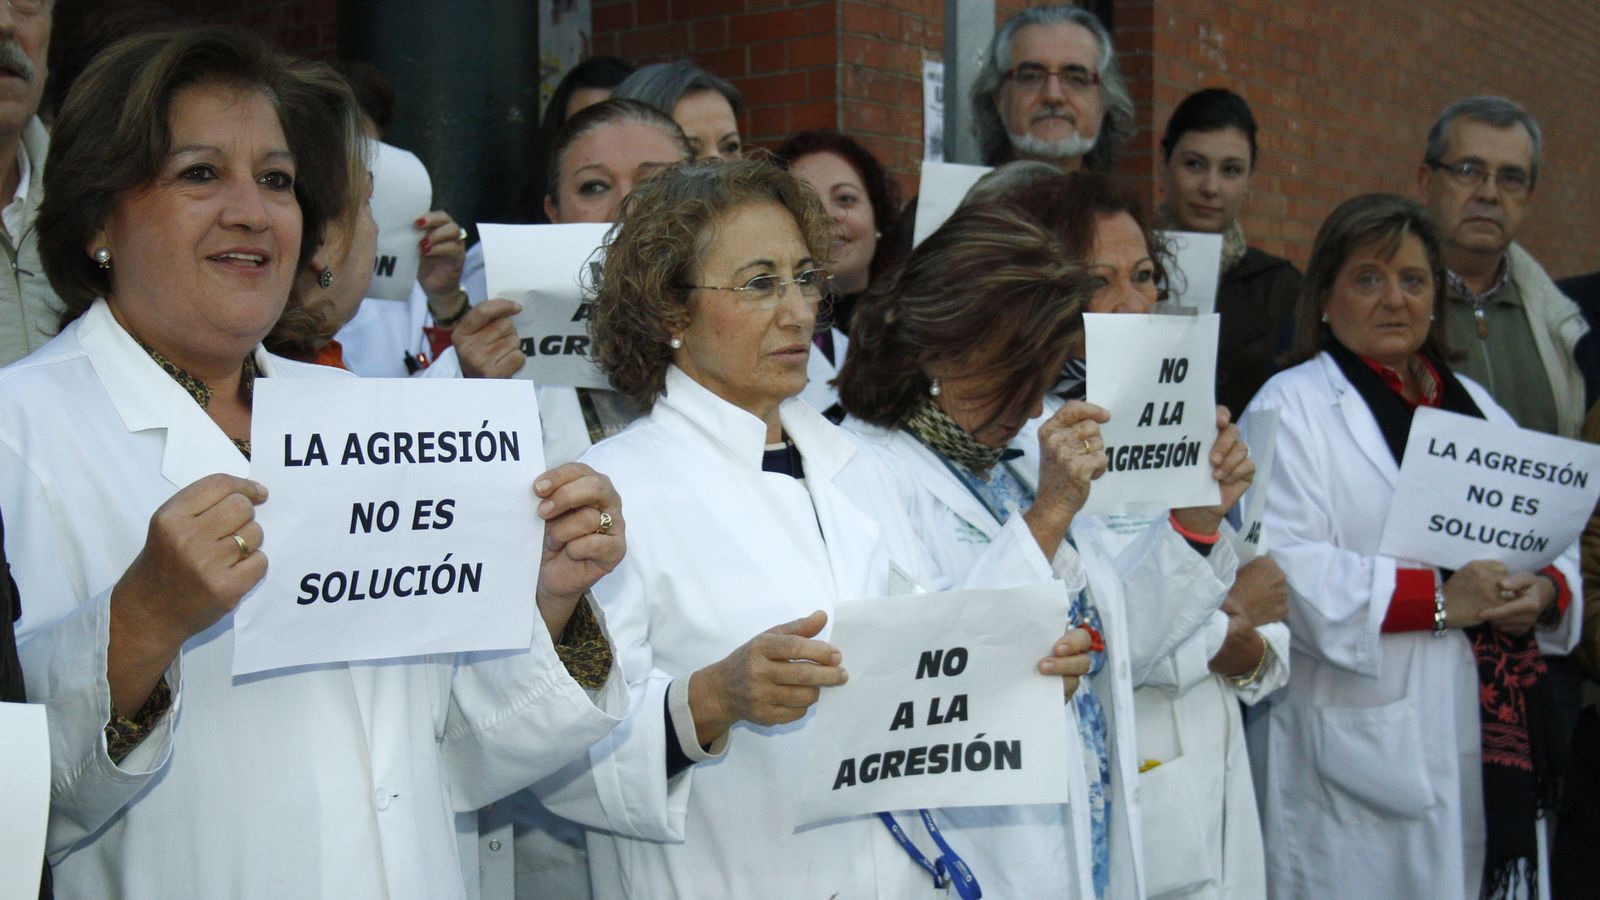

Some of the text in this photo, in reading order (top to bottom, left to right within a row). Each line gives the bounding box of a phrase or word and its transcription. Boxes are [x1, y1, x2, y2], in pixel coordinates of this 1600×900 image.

[1158, 357, 1188, 383] NO
[1137, 401, 1185, 428] A LA
[284, 420, 521, 467] LA AGRESIÓN
[1105, 436, 1200, 472] AGRESIÓN
[1427, 437, 1589, 489] LA AGRESIÓN
[349, 498, 456, 534] NO ES
[1466, 484, 1540, 516] NO ES
[1427, 514, 1549, 553] SOLUCIÓN
[296, 552, 483, 606] SOLUCIÓN
[915, 646, 969, 680] NO
[889, 694, 969, 732] A LA
[832, 732, 1022, 791] AGRESIÓN
